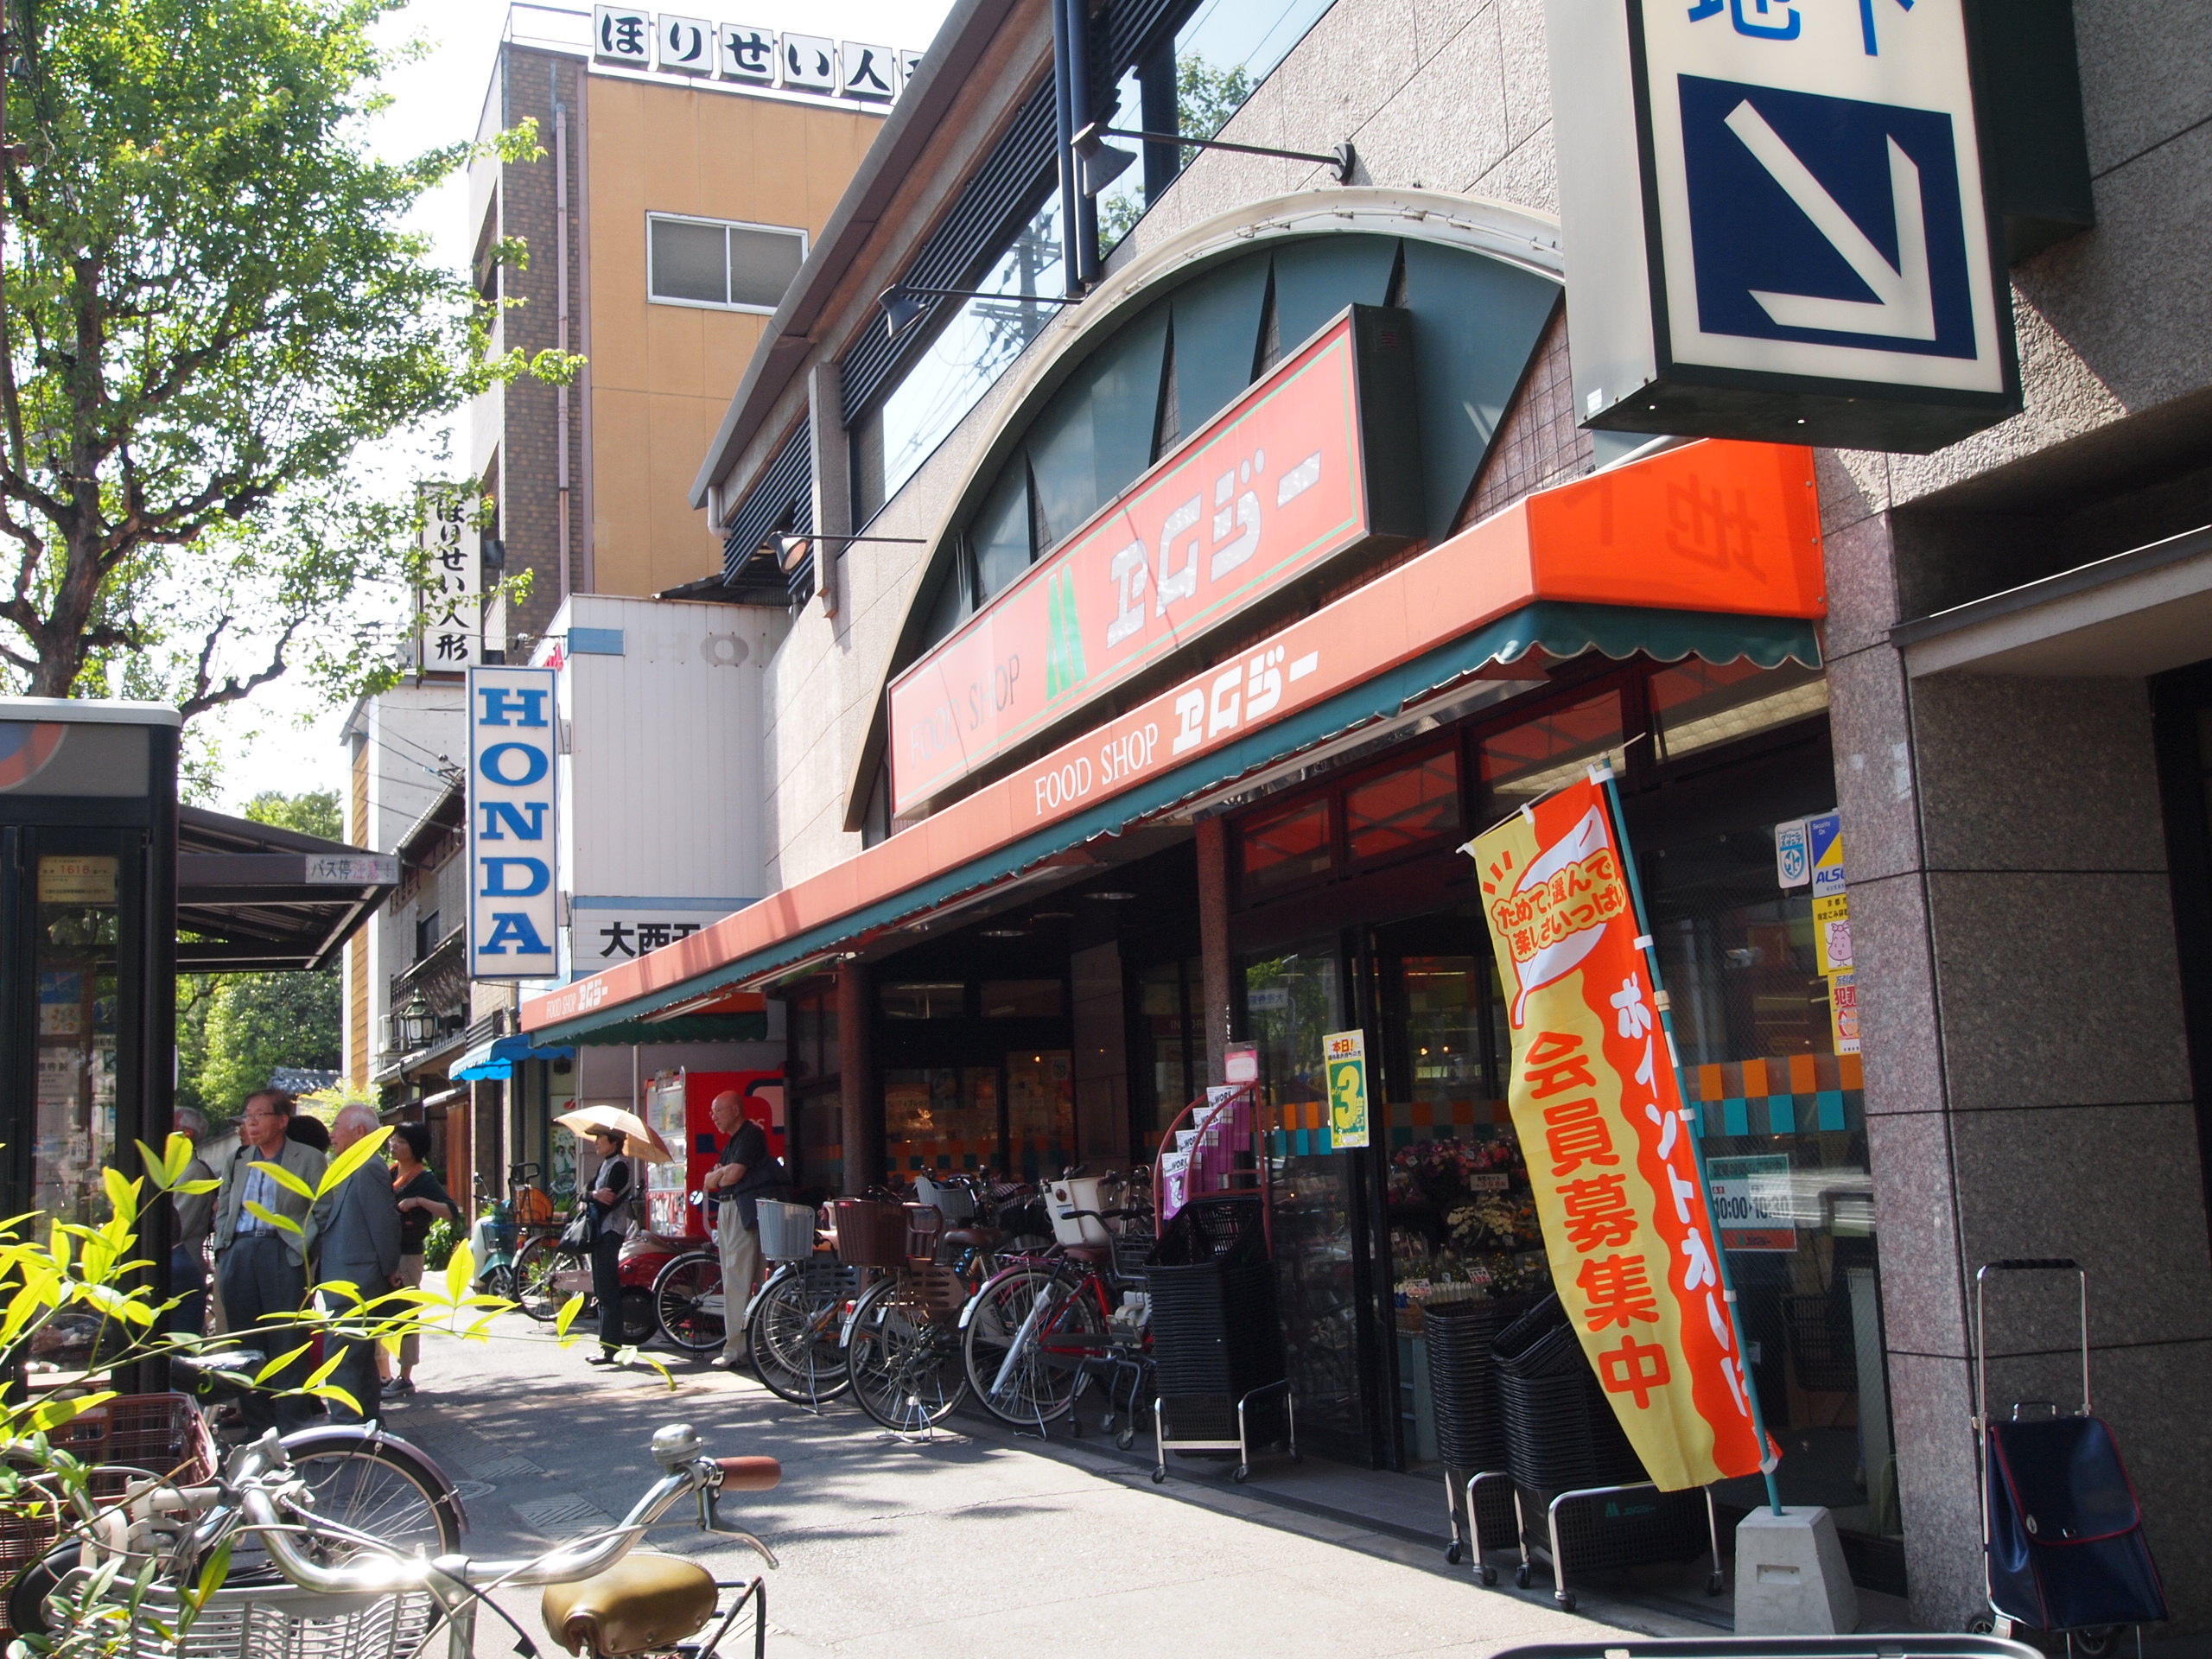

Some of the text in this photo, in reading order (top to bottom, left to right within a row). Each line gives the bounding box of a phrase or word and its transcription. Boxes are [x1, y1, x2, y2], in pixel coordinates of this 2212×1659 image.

[435, 498, 470, 662] ほりせい人形
[969, 653, 1020, 730] SHOP
[1033, 721, 1159, 817] FOOD SHOP
[478, 686, 553, 956] HONDA
[1512, 880, 1624, 957] 楽しさいっぱい
[546, 992, 577, 1020] FOOD SHOP
[1214, 1090, 1232, 1104] WORK
[1335, 1065, 1360, 1129] 3
[1171, 1156, 1189, 1170] WORK
[1184, 1134, 1199, 1147] WOR
[1524, 1032, 1672, 1410] 会員募集中
[1713, 1196, 1748, 1219] 10:00
